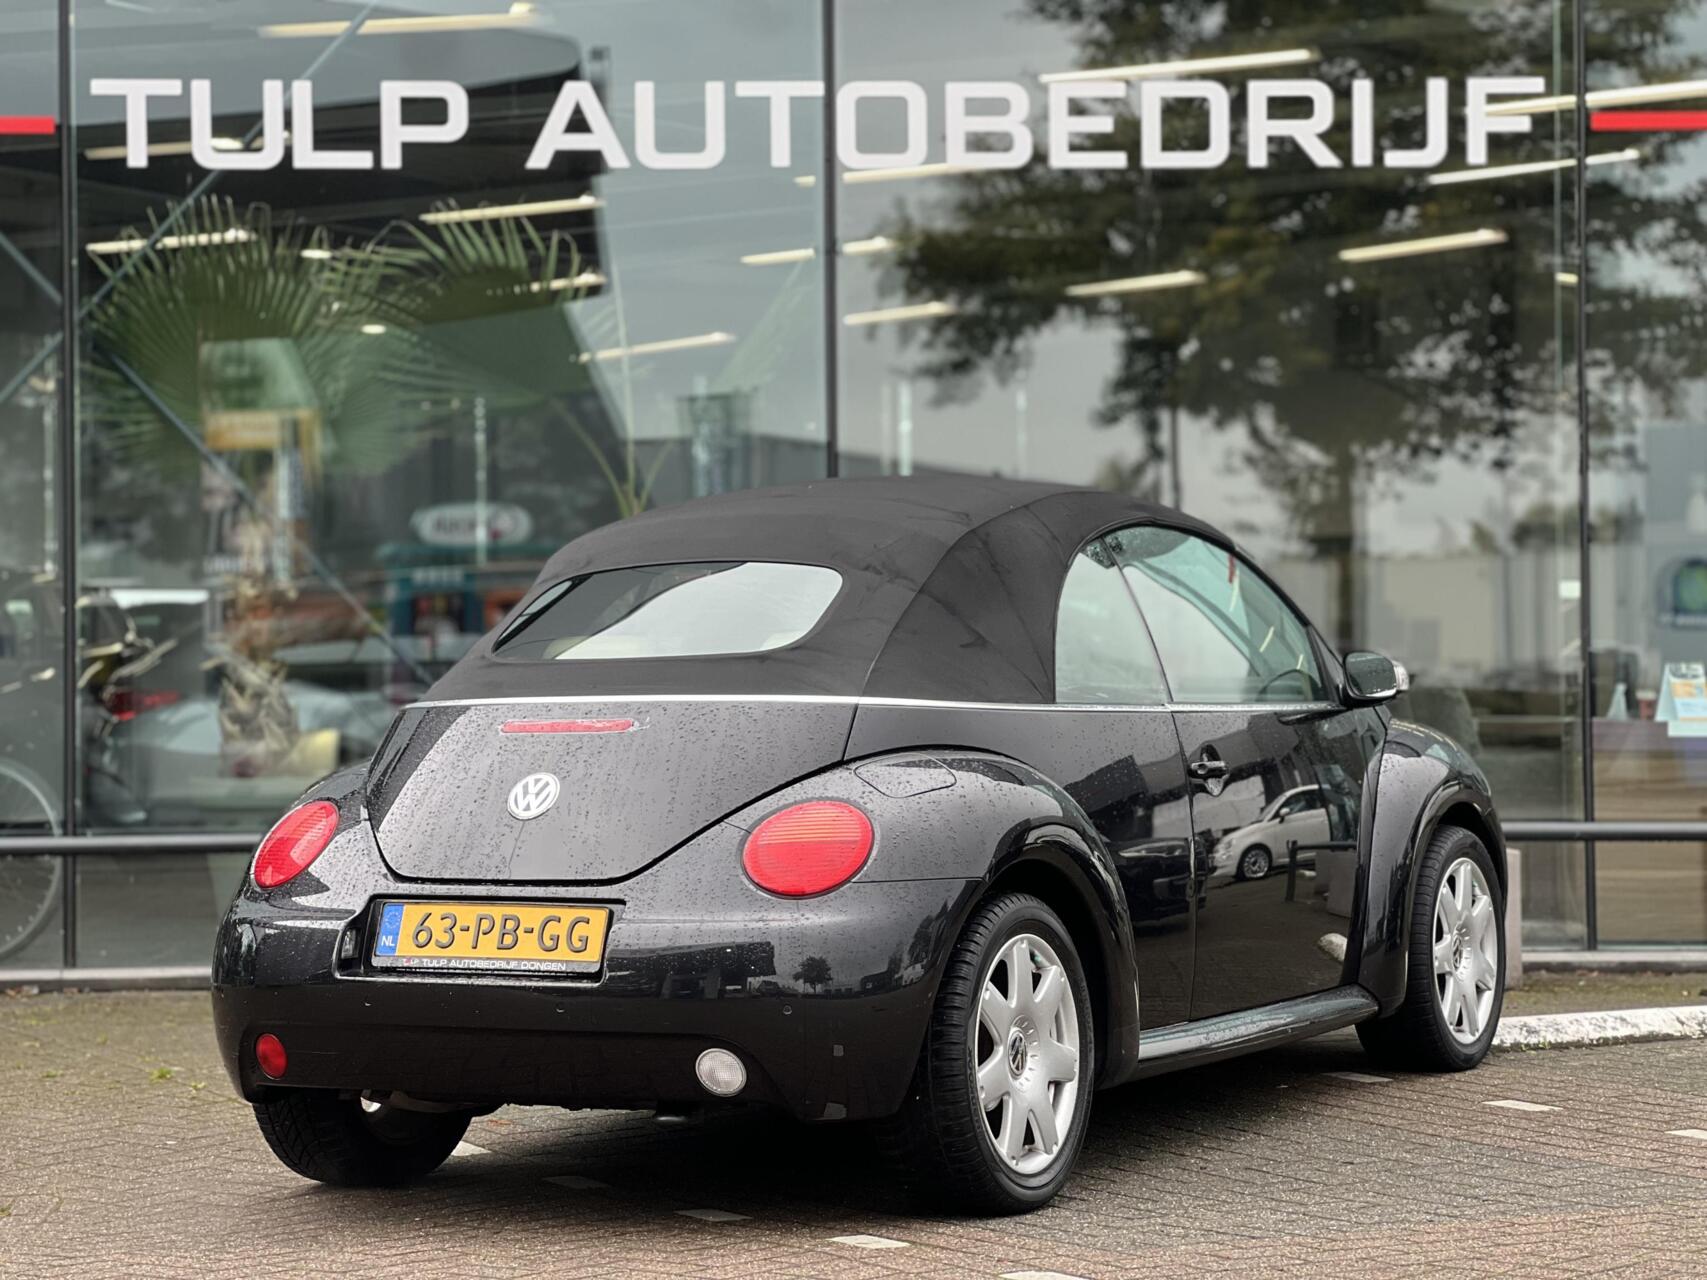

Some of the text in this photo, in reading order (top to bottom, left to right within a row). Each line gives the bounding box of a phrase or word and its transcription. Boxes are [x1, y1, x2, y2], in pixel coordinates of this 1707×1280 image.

[90, 77, 1545, 170] TULP AUTOBEDRIJF
[381, 935, 395, 947] NL
[411, 912, 590, 952] 63-PB-GG
[422, 958, 448, 967] TULP
[450, 959, 518, 969] AUTOBEDRIJF
[520, 961, 566, 971] DONGEN
